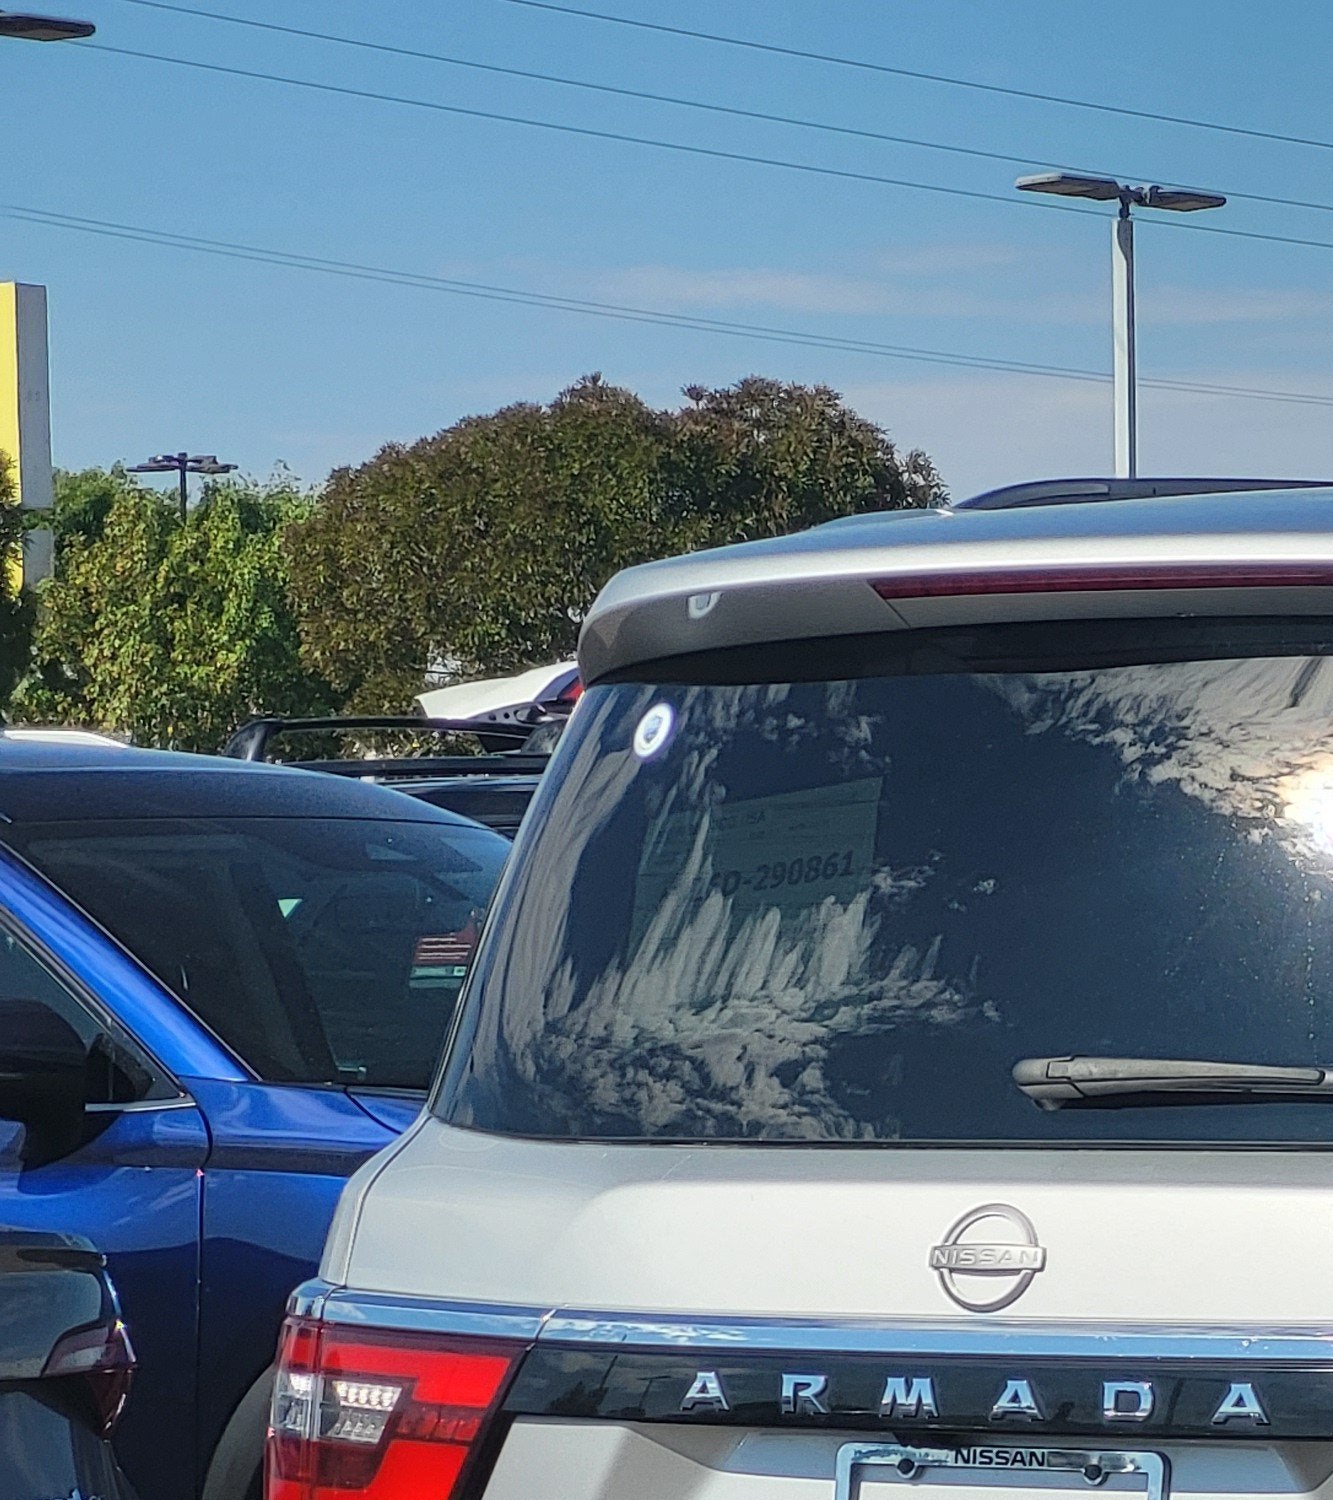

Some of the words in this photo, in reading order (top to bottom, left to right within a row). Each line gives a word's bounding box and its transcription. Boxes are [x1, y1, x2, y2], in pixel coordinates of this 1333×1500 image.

[932, 1248, 1038, 1266] NISSAN
[679, 1370, 1271, 1428] ARMADA
[954, 1448, 1048, 1468] NISSAN
